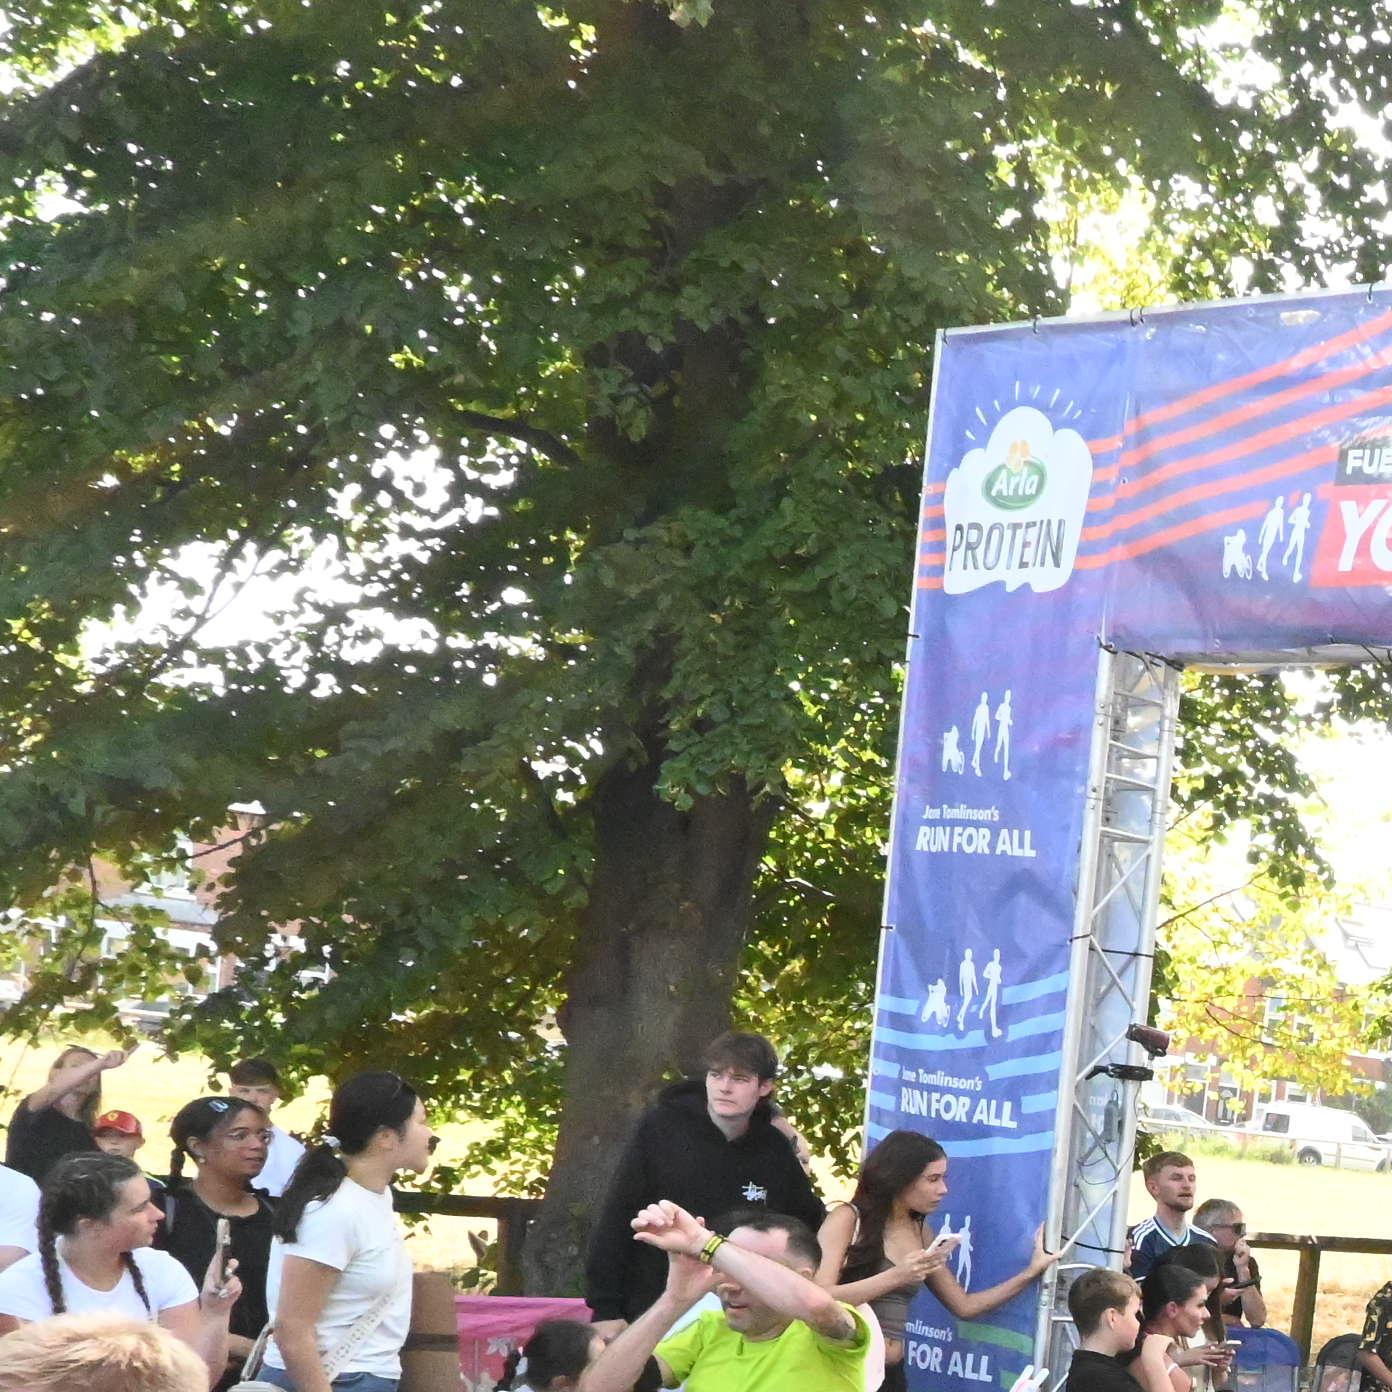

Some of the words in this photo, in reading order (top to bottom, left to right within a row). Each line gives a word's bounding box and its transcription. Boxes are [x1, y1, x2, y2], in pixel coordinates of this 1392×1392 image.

[990, 467, 1042, 499] Arla
[950, 518, 1066, 572] PROTEIN
[942, 803, 999, 821] Tomlinson's
[915, 826, 950, 852] RUN
[952, 826, 990, 854] FOR
[995, 828, 1036, 857] ALL
[918, 1068, 983, 1091] Tomlinson's
[900, 1086, 928, 1117] RUN
[930, 1092, 971, 1121] FOR
[972, 1098, 1017, 1128] ALL
[905, 1319, 953, 1342] mlinson's
[908, 1340, 943, 1373] FOR
[947, 1351, 993, 1383] ALL
